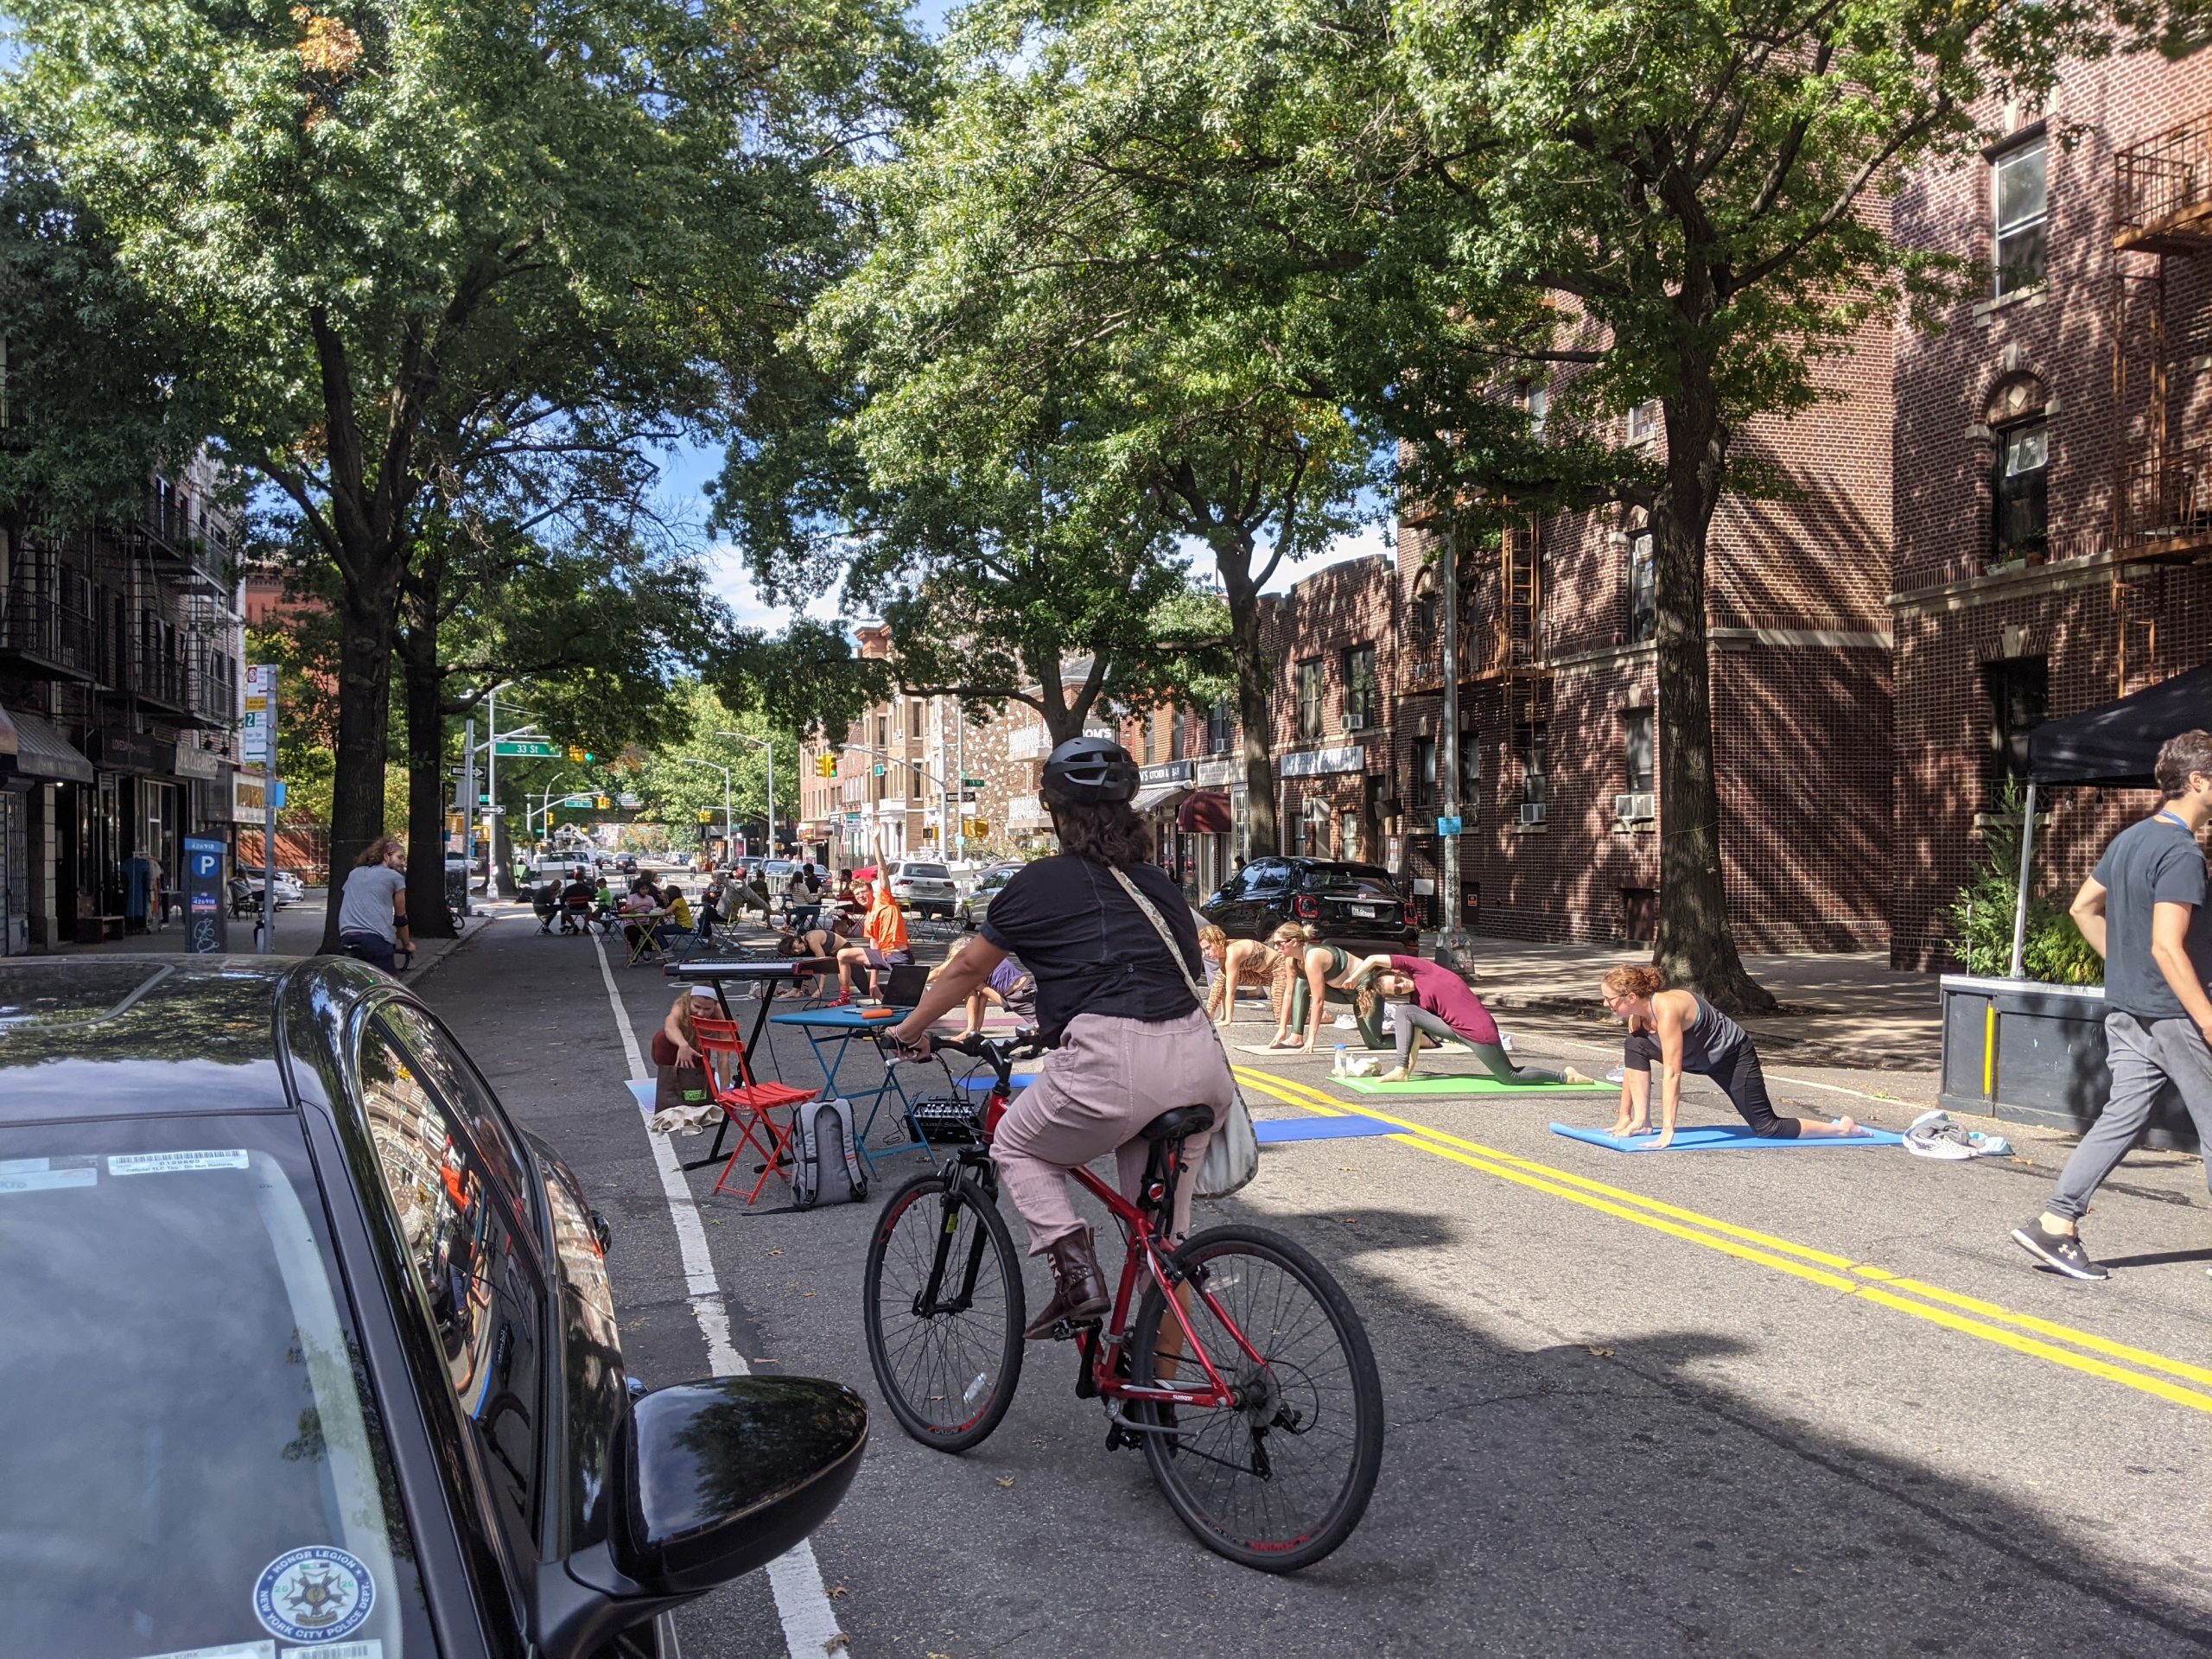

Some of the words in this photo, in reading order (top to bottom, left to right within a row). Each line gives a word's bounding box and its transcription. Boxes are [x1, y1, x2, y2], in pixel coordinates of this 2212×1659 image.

[247, 714, 253, 727] 2
[1082, 728, 1112, 739] OM'S
[517, 745, 526, 753] 33
[530, 744, 539, 753] St
[200, 855, 215, 874] P
[272, 1550, 312, 1574] HONOR
[315, 1549, 356, 1569] LEGION
[274, 1585, 289, 1593] 20
[260, 1590, 271, 1612] NEW
[266, 1612, 296, 1636] YORK
[295, 1630, 325, 1639] CITY
[327, 1611, 363, 1637] POLICE
[359, 1580, 371, 1611] DEPT.
